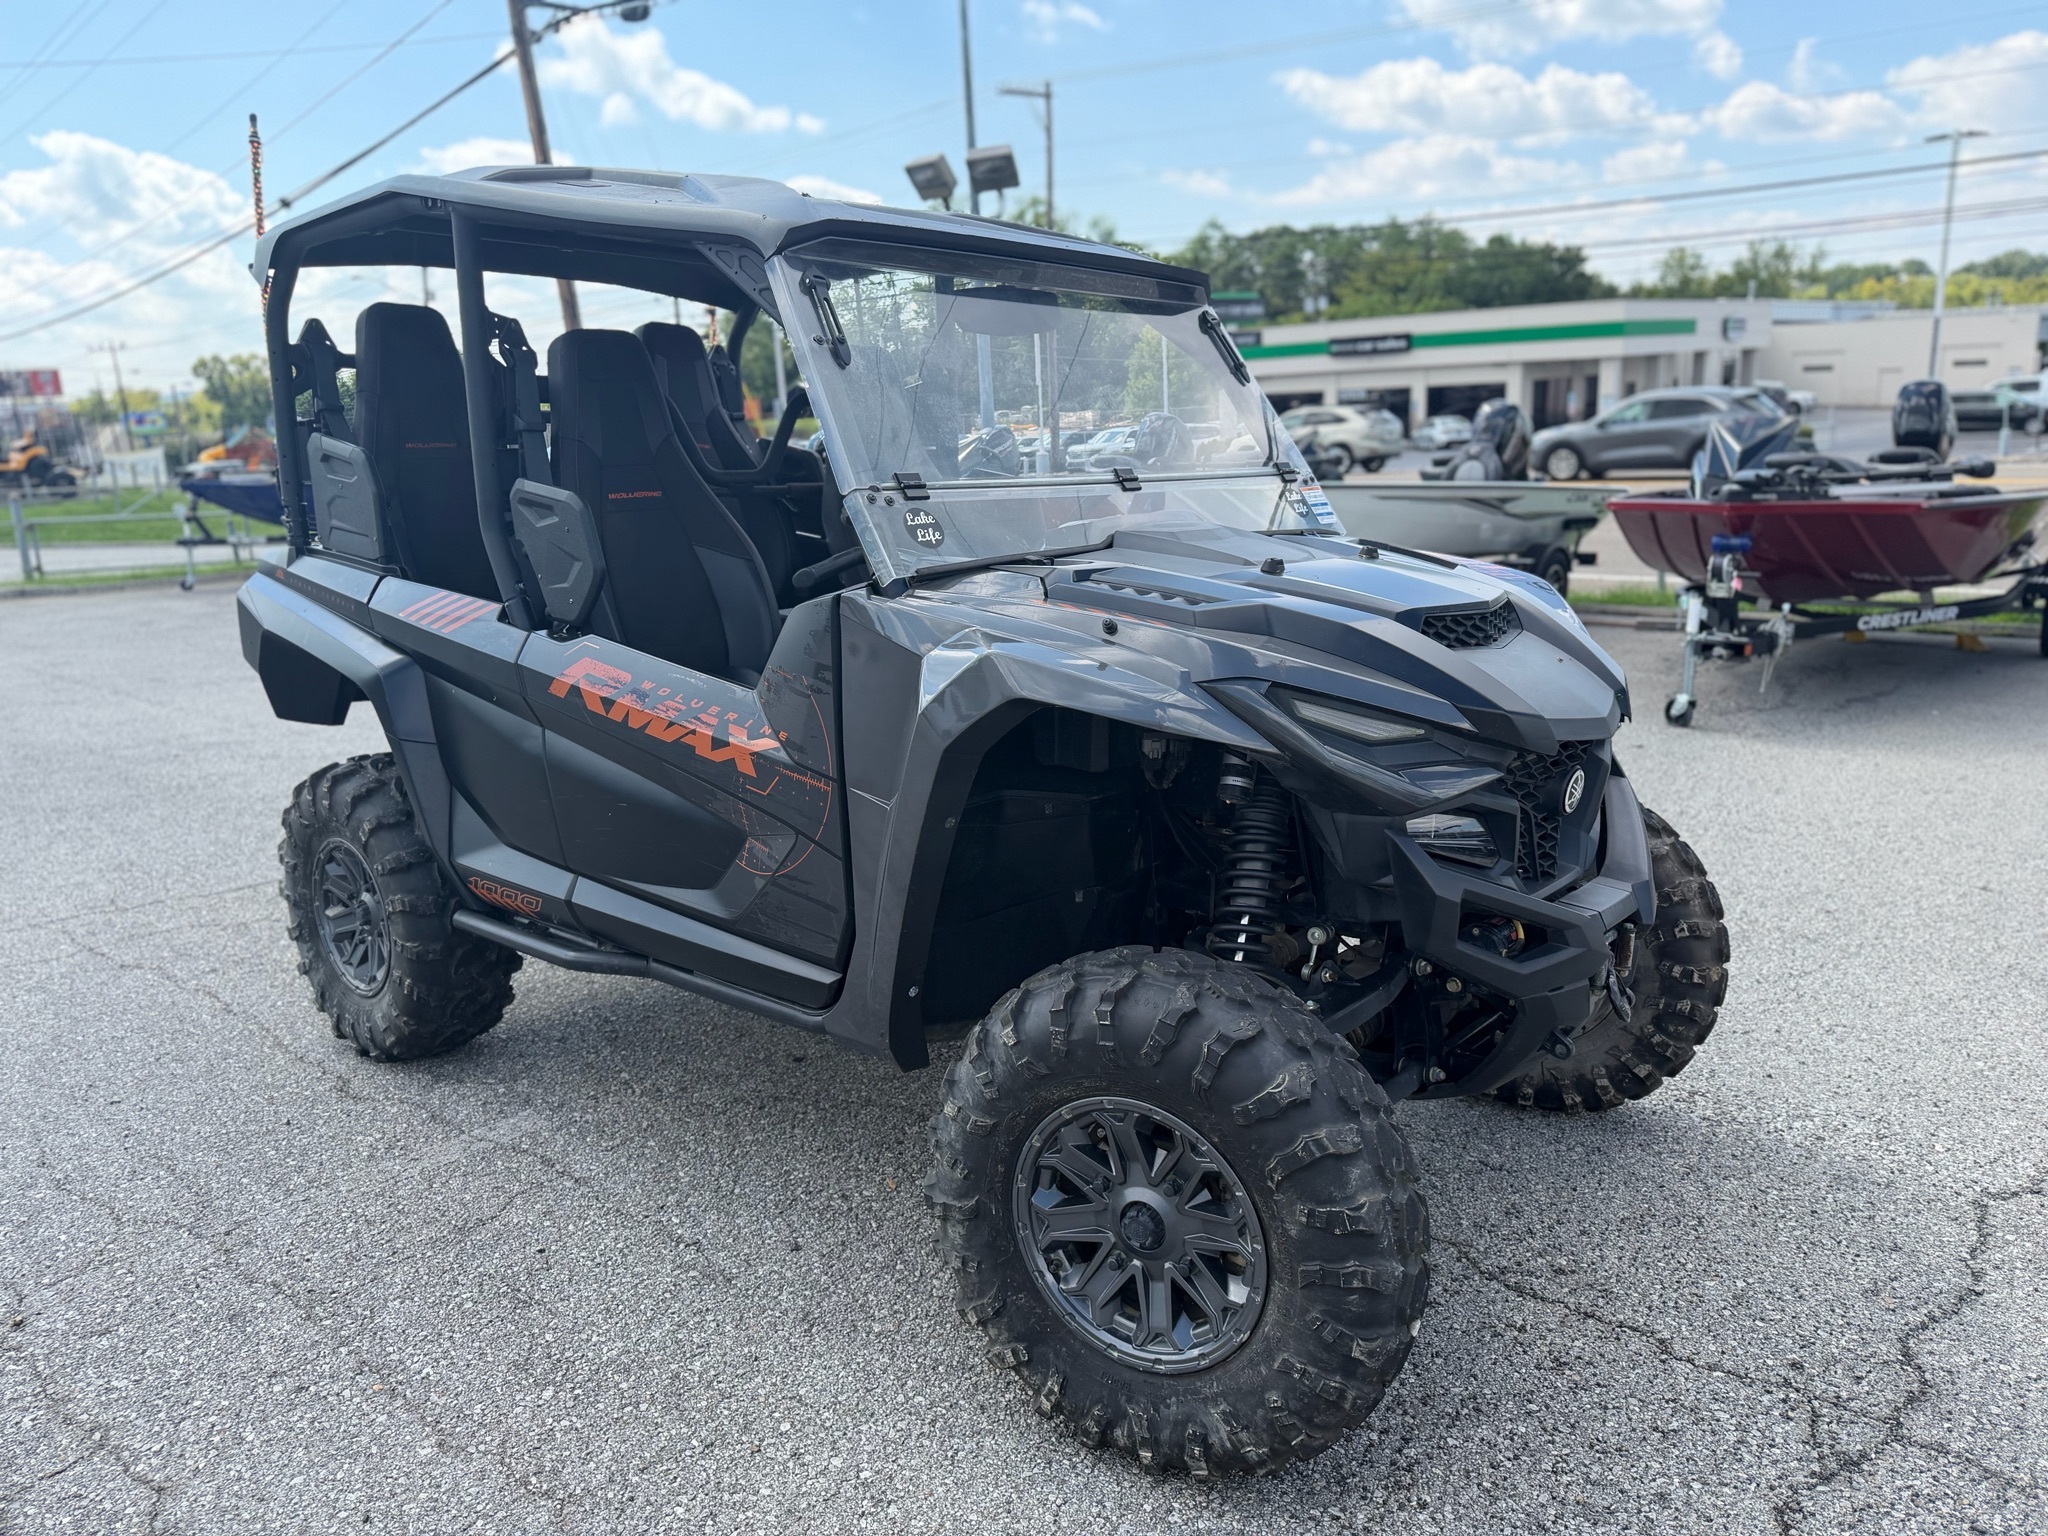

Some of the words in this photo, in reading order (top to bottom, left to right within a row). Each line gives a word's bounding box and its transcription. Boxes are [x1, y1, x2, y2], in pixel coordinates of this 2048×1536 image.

[607, 490, 663, 500] WOLVERINE
[1284, 490, 1303, 501] Lake
[905, 511, 936, 526] Lake
[916, 527, 943, 545] Life
[1857, 605, 1960, 632] CRESTLINER
[547, 656, 782, 778] RMAX
[641, 679, 788, 742] WOLVERINE
[466, 876, 543, 917] 1000
